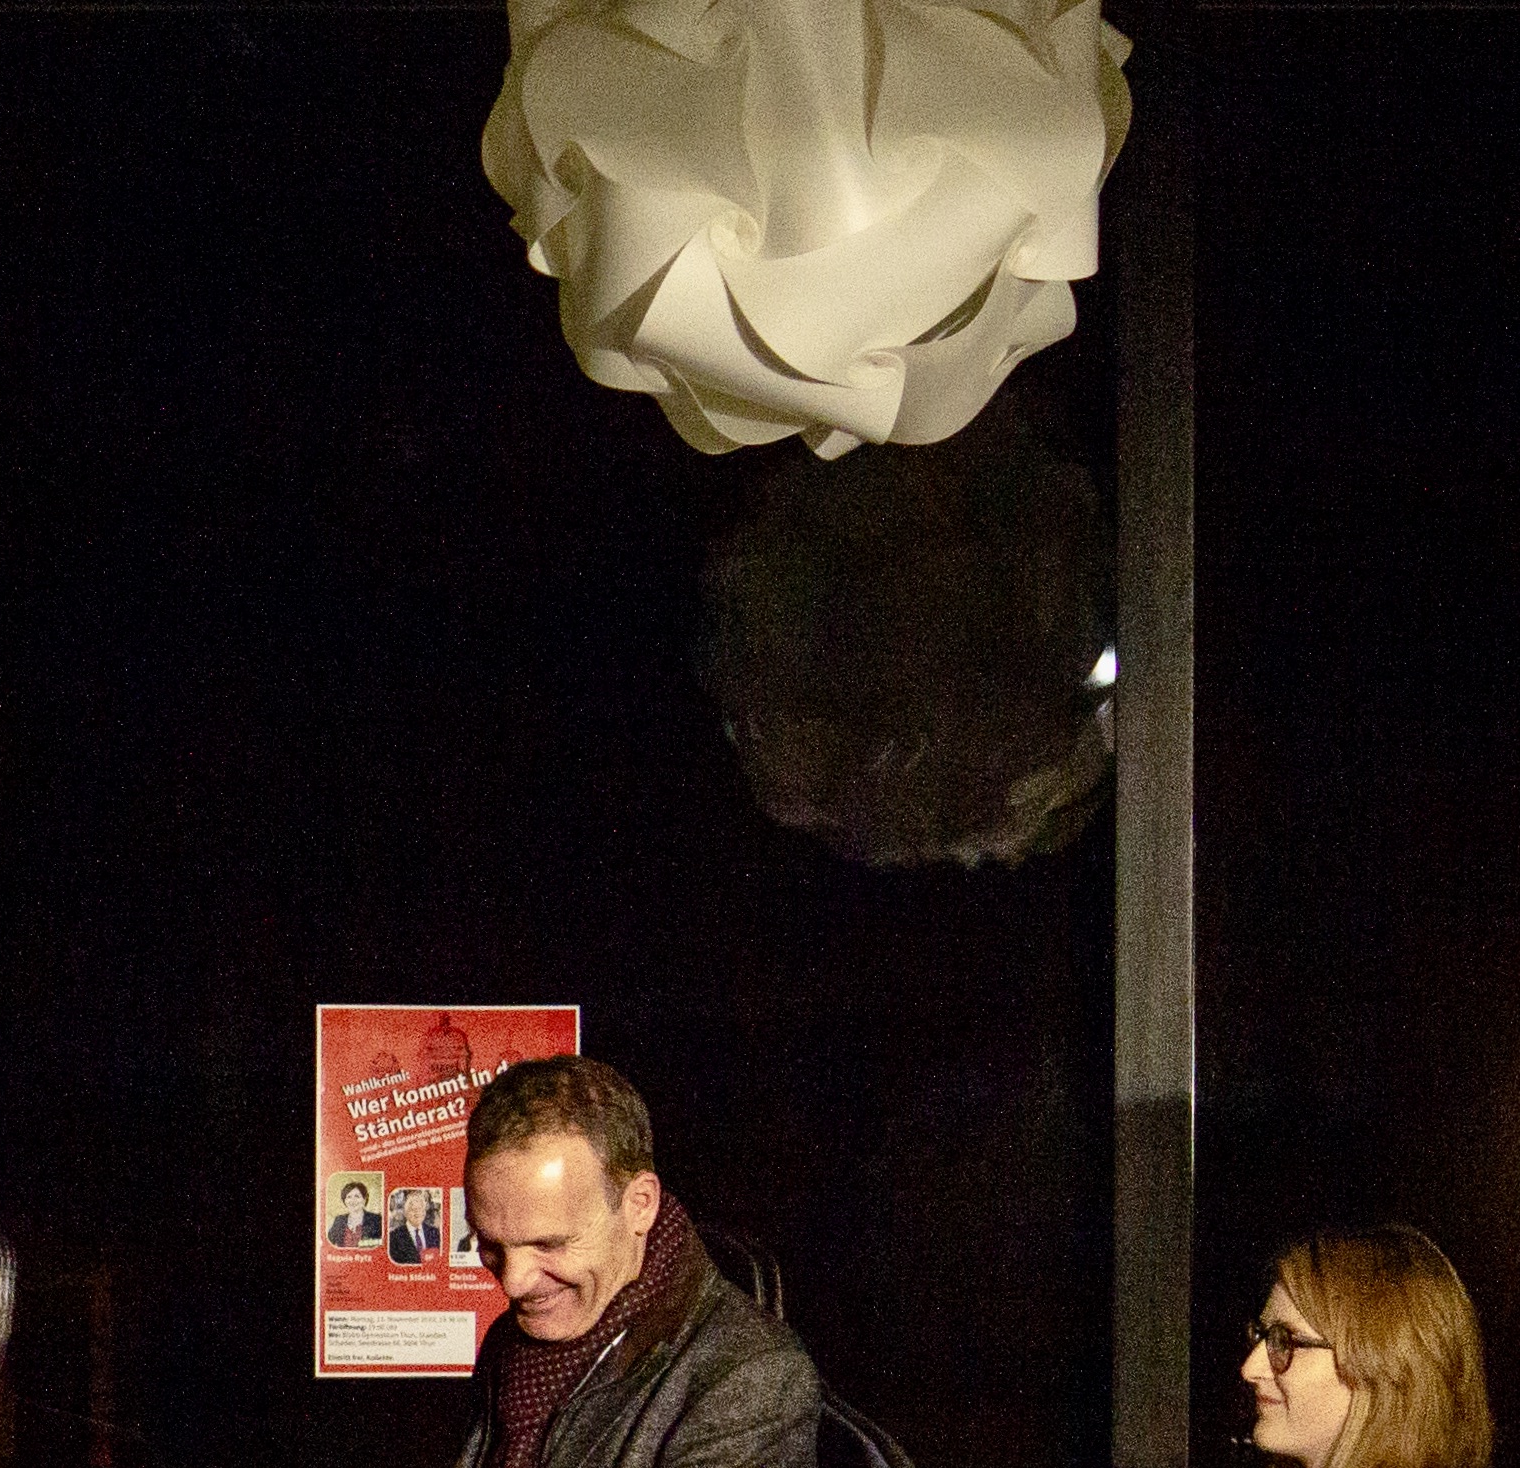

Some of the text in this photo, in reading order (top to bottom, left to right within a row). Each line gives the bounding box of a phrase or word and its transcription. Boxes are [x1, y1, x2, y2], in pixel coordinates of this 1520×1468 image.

[341, 1068, 410, 1097] Wahlkrimi:
[347, 1096, 389, 1119] Wer
[393, 1073, 469, 1110] kommt
[470, 1066, 492, 1088] in
[354, 1096, 467, 1143] Ständerat?
